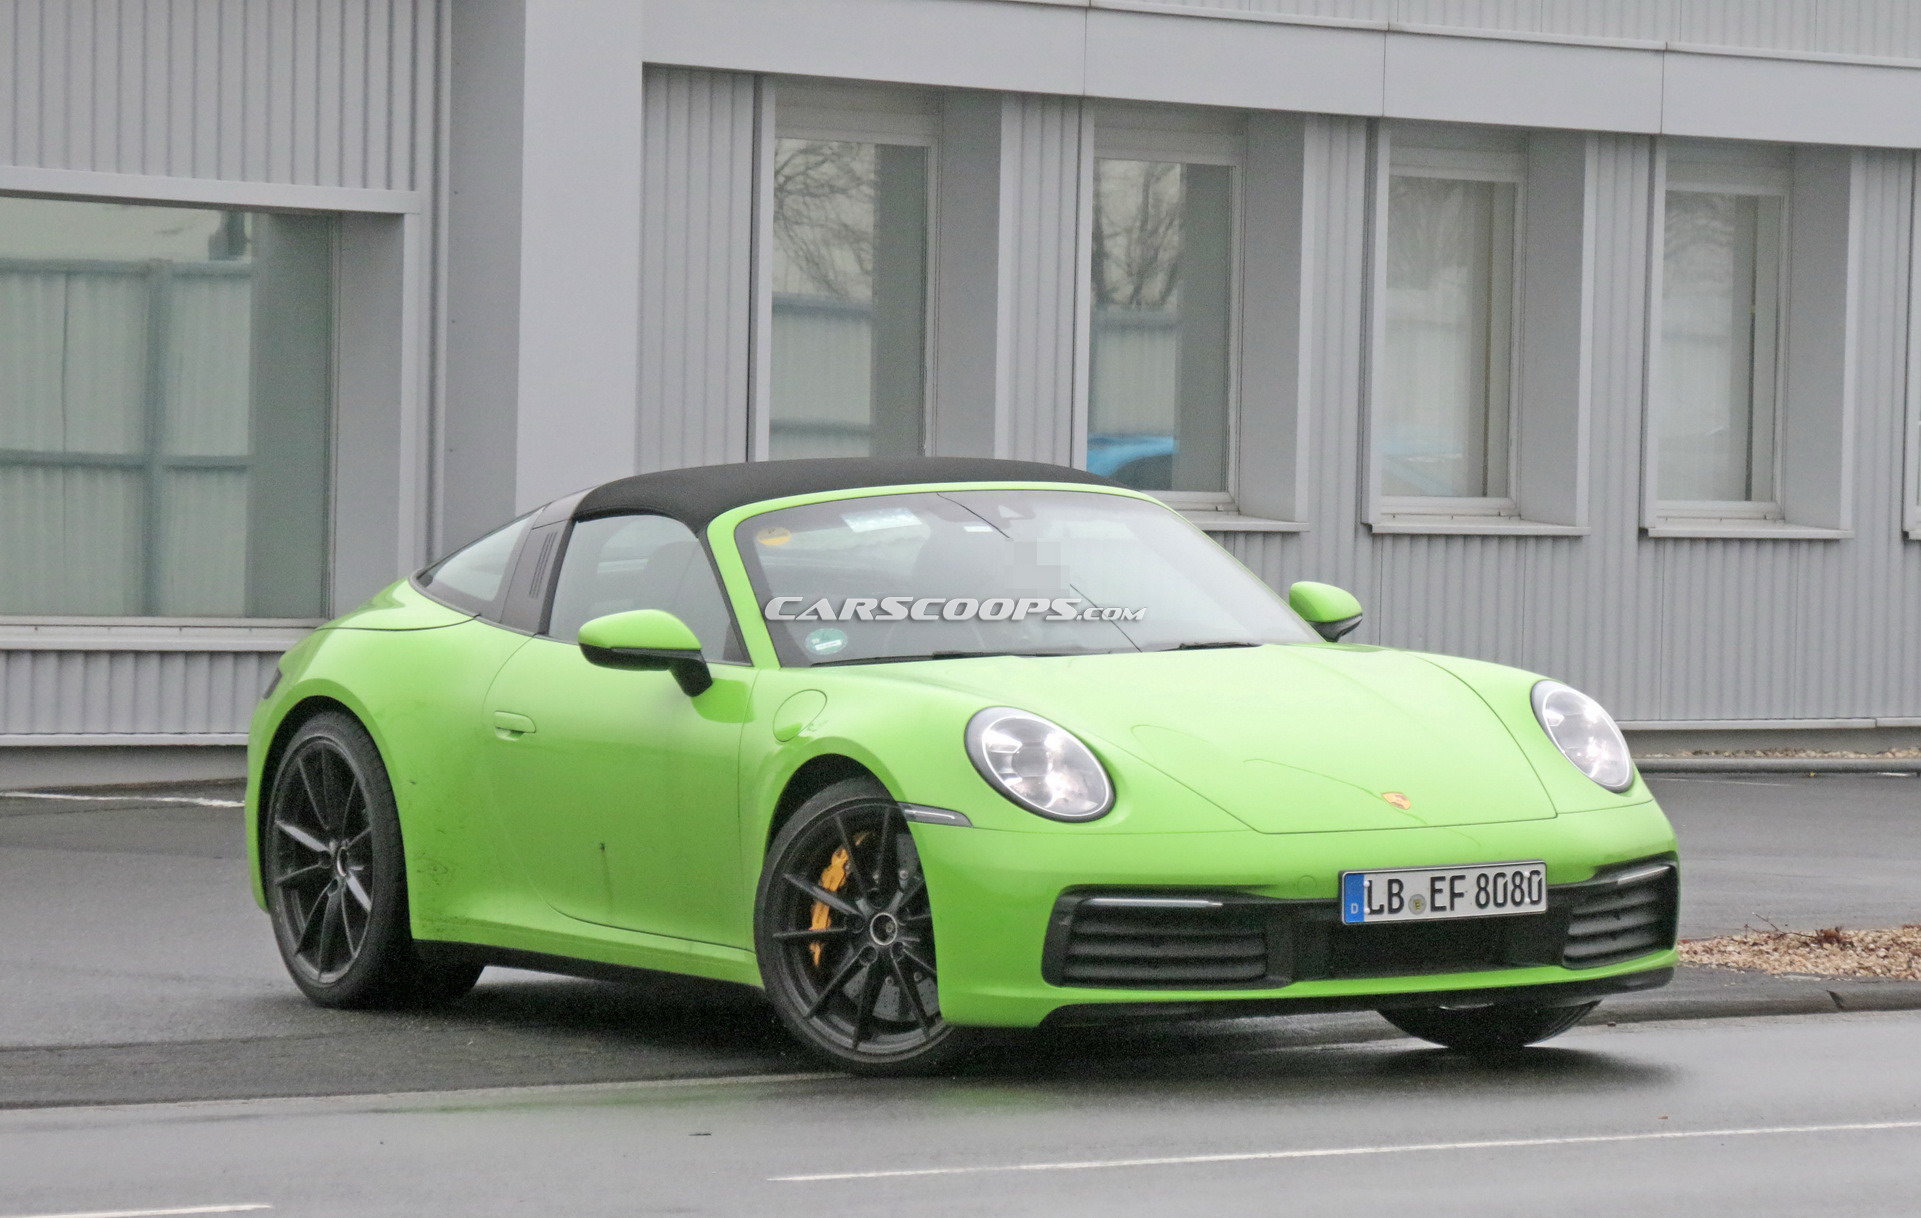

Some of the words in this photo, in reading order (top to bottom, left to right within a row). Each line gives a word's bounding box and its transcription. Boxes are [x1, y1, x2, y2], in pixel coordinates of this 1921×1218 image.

[1366, 878, 1404, 915] LB
[1430, 875, 1466, 912] EF
[1475, 870, 1542, 909] 8080
[1350, 903, 1359, 914] D
